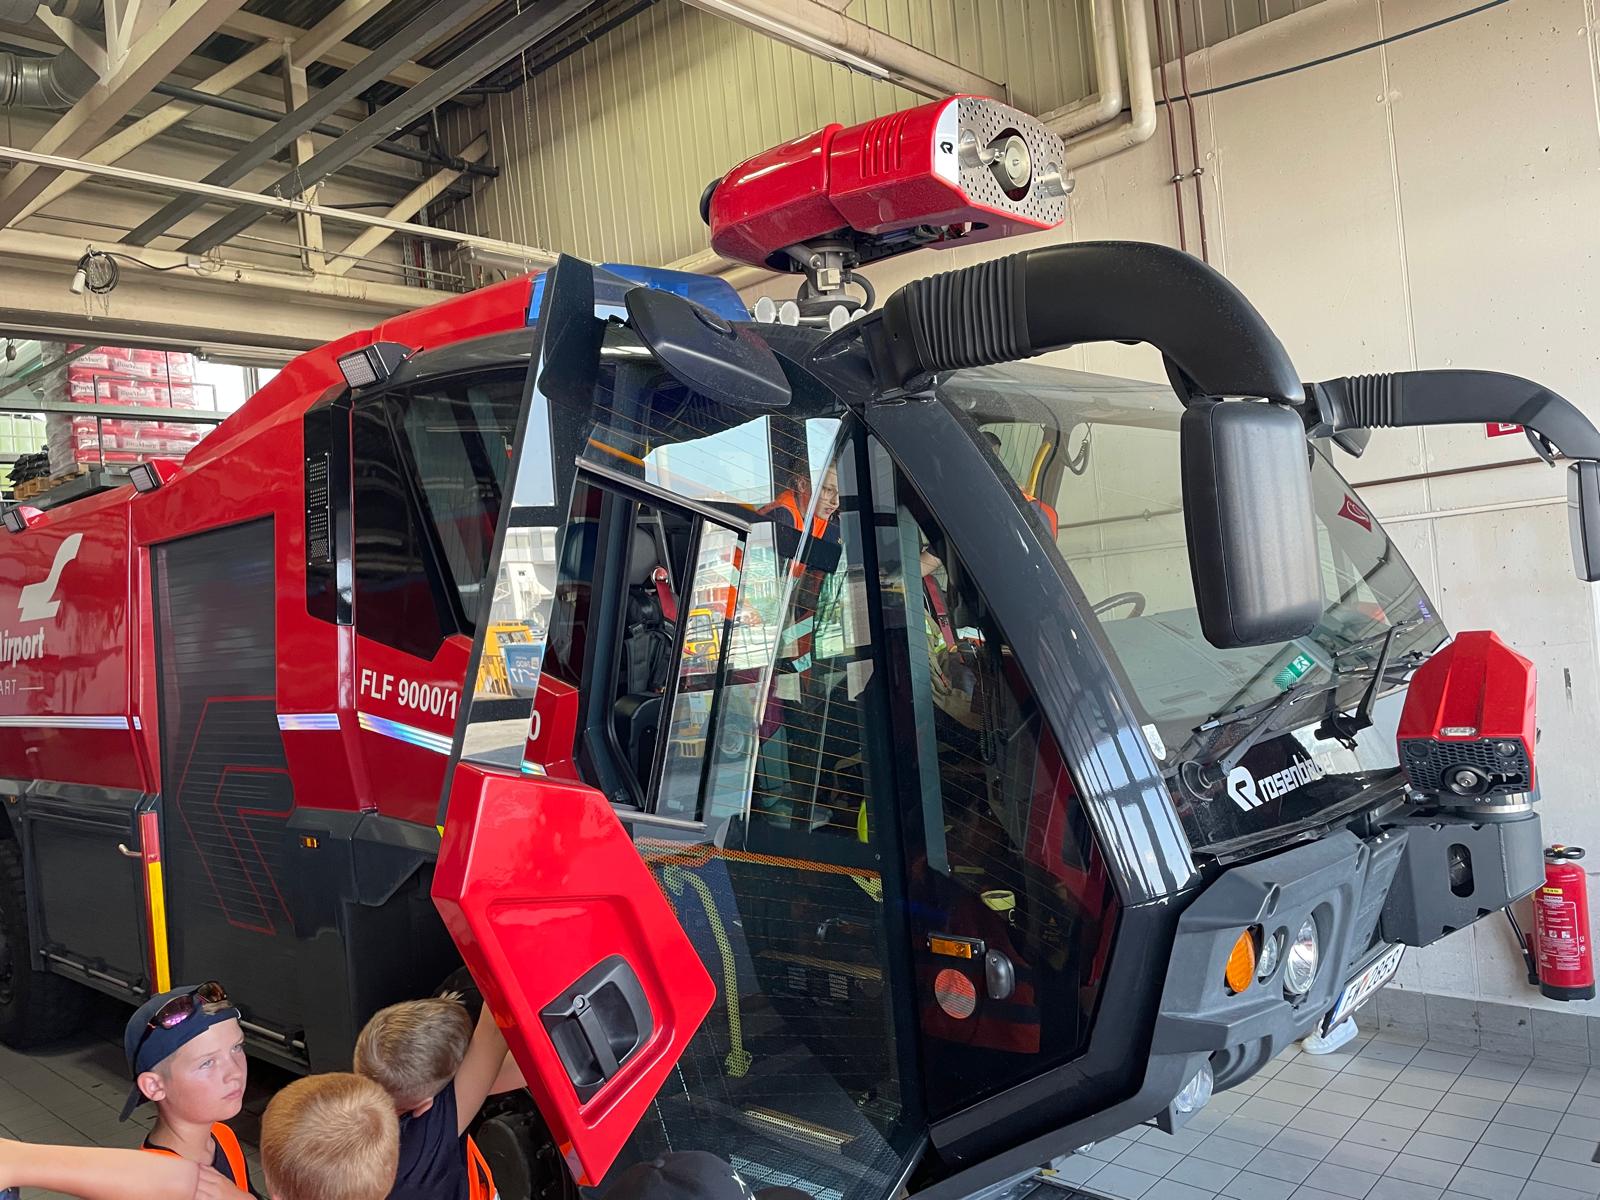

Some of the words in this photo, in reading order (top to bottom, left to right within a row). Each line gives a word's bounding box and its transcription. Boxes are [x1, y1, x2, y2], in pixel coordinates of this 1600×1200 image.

[0, 626, 45, 668] irport
[360, 668, 394, 701] FLF
[398, 678, 461, 720] 9000/1
